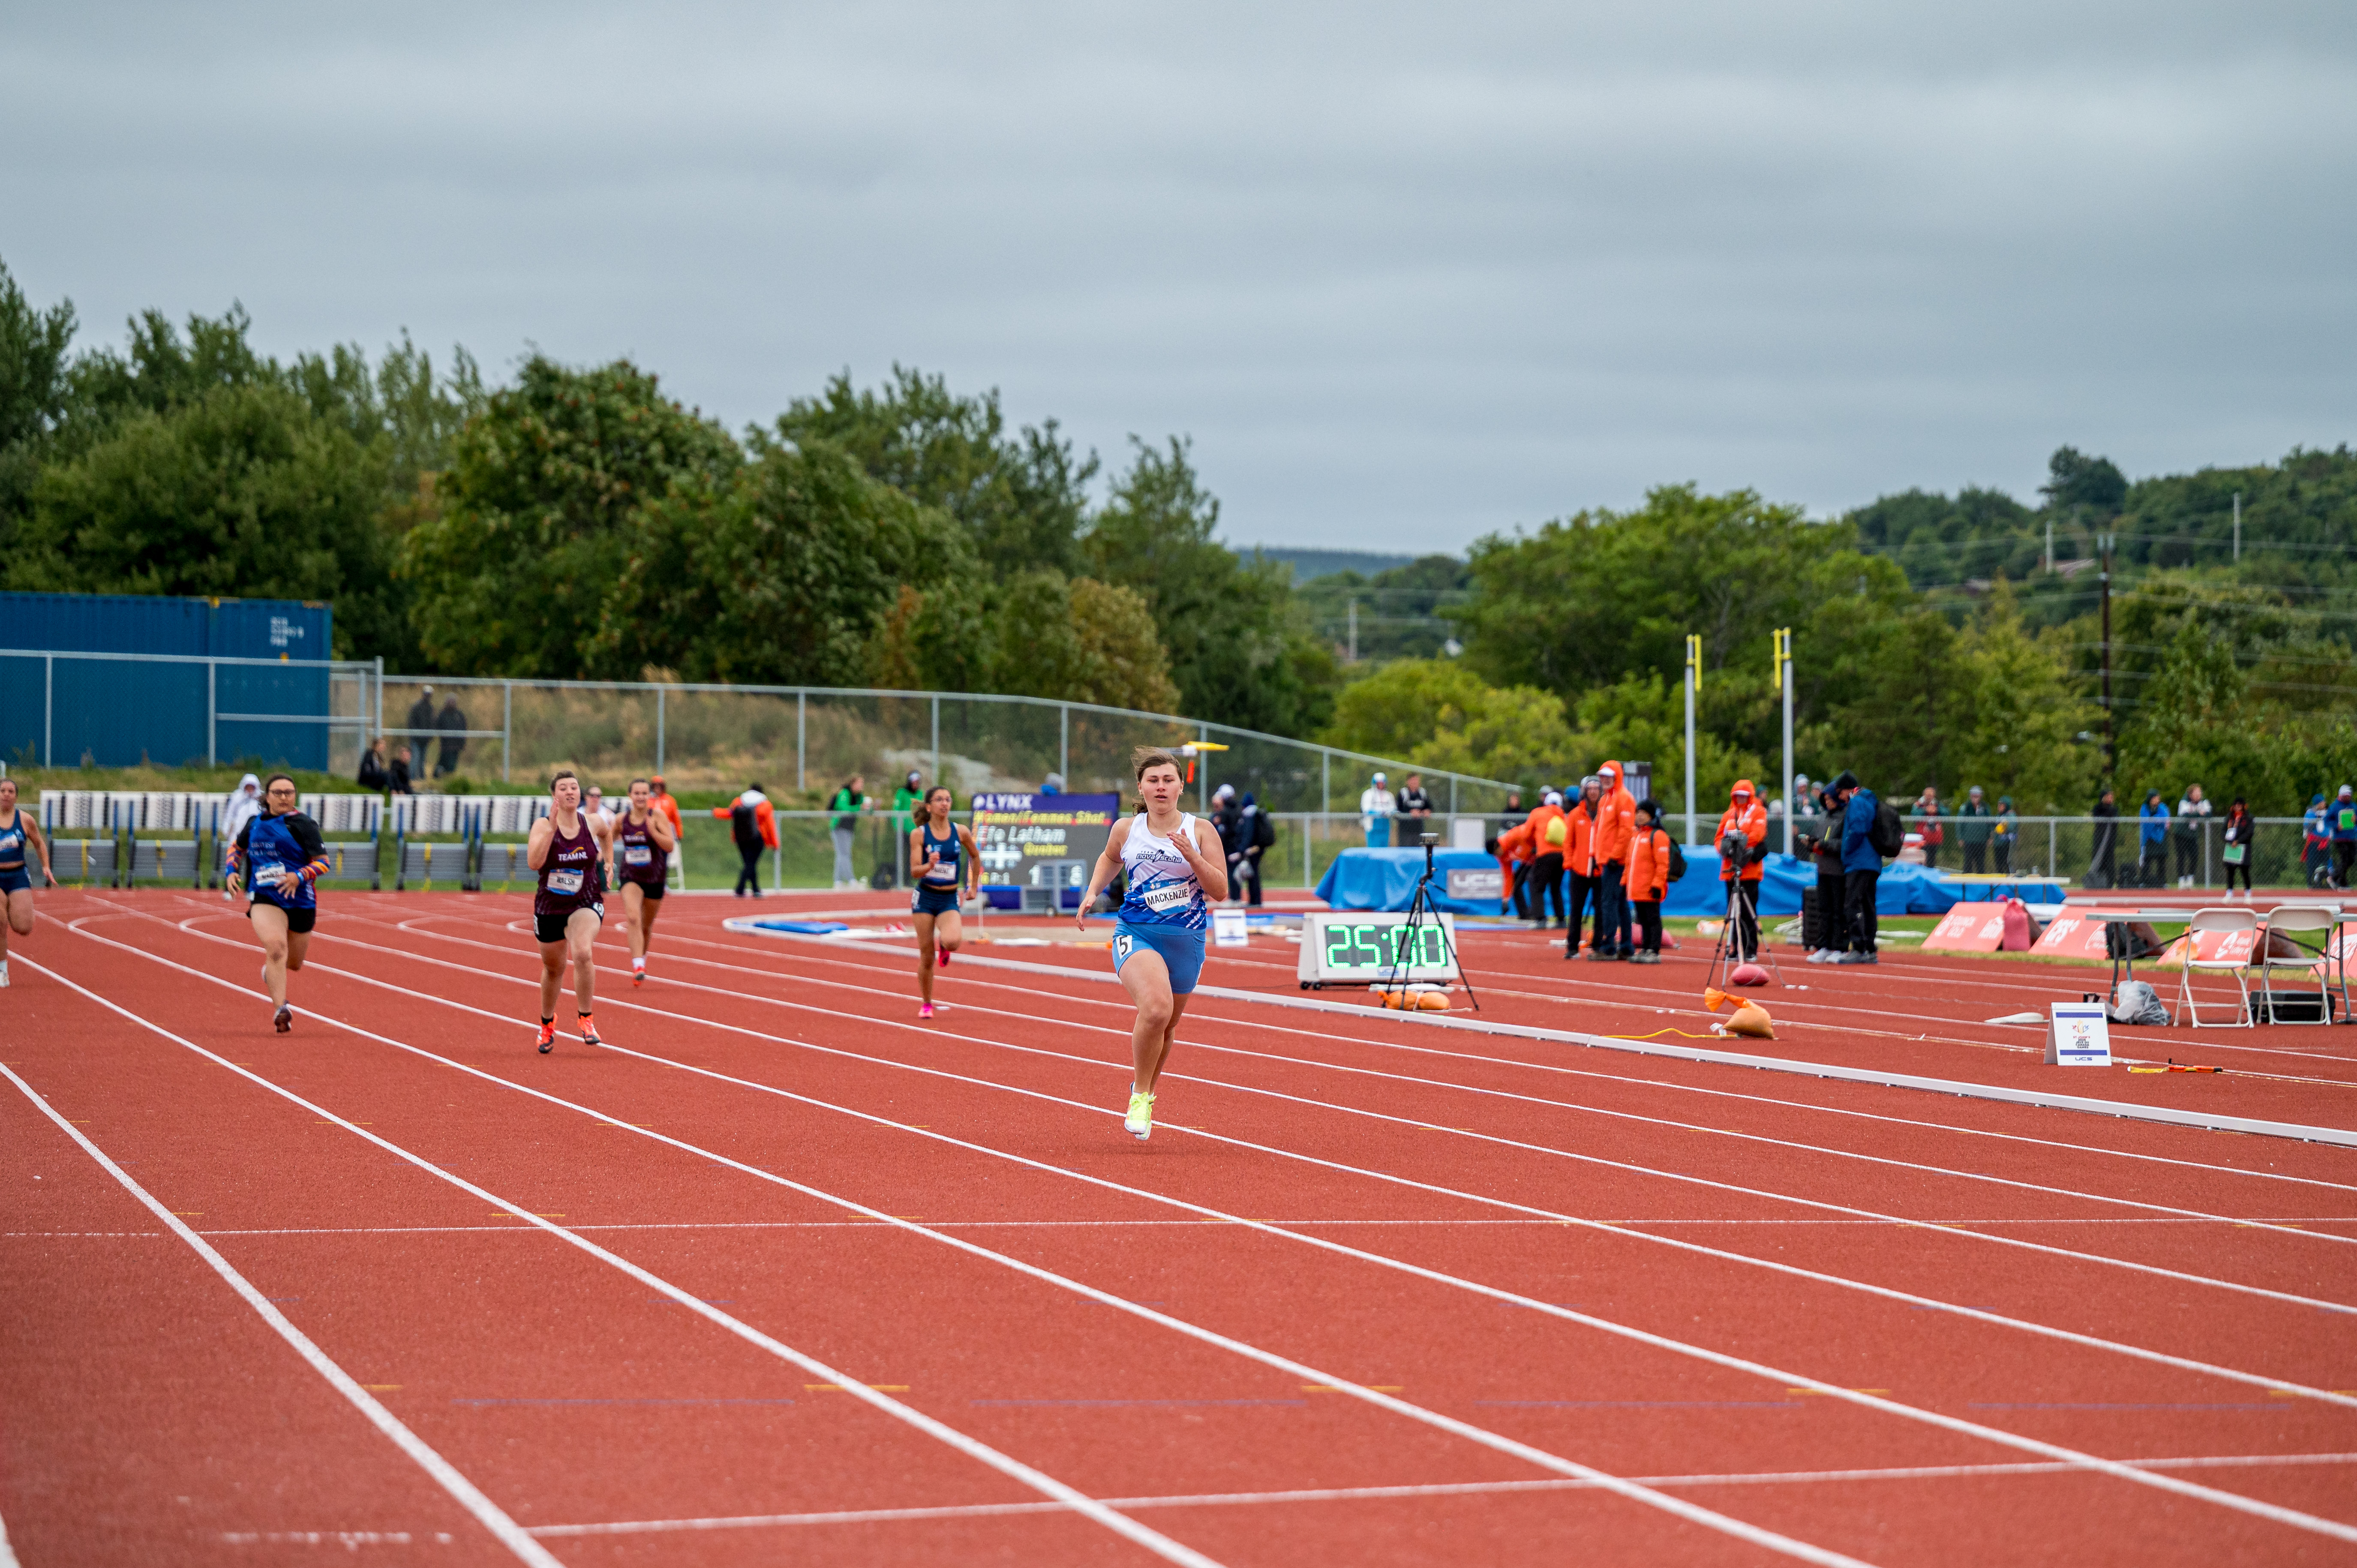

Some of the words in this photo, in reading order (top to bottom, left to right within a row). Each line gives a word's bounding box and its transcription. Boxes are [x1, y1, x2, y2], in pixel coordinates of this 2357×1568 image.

[986, 794, 1033, 810] LYNX
[558, 853, 578, 861] TEAM
[578, 851, 588, 860] NL
[1147, 888, 1189, 905] MACKENZIE
[1119, 935, 1128, 956] 5
